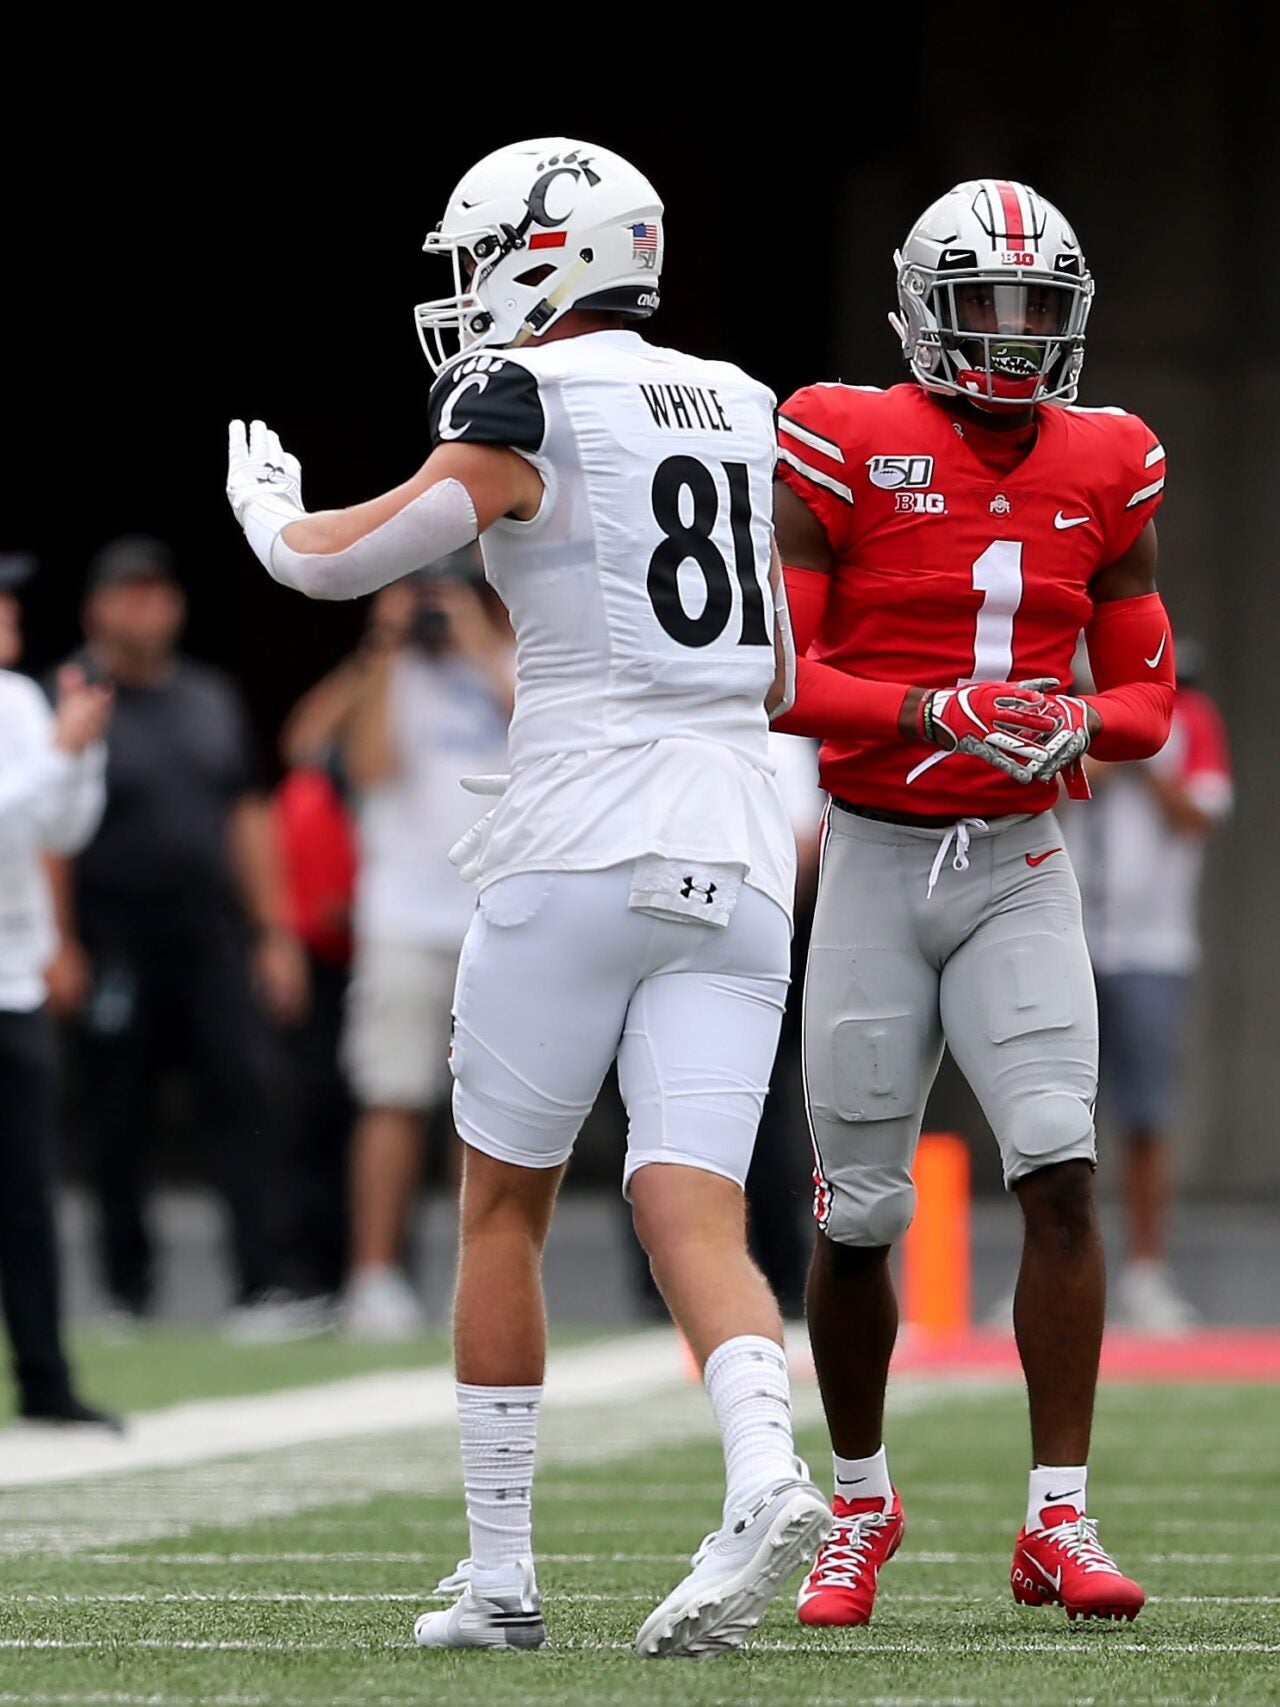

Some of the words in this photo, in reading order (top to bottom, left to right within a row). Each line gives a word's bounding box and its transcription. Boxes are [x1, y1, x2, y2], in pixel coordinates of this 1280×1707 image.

[639, 384, 733, 432] WHYLE
[865, 456, 933, 489] 150
[646, 454, 773, 648] 81
[956, 539, 1023, 685] 1
